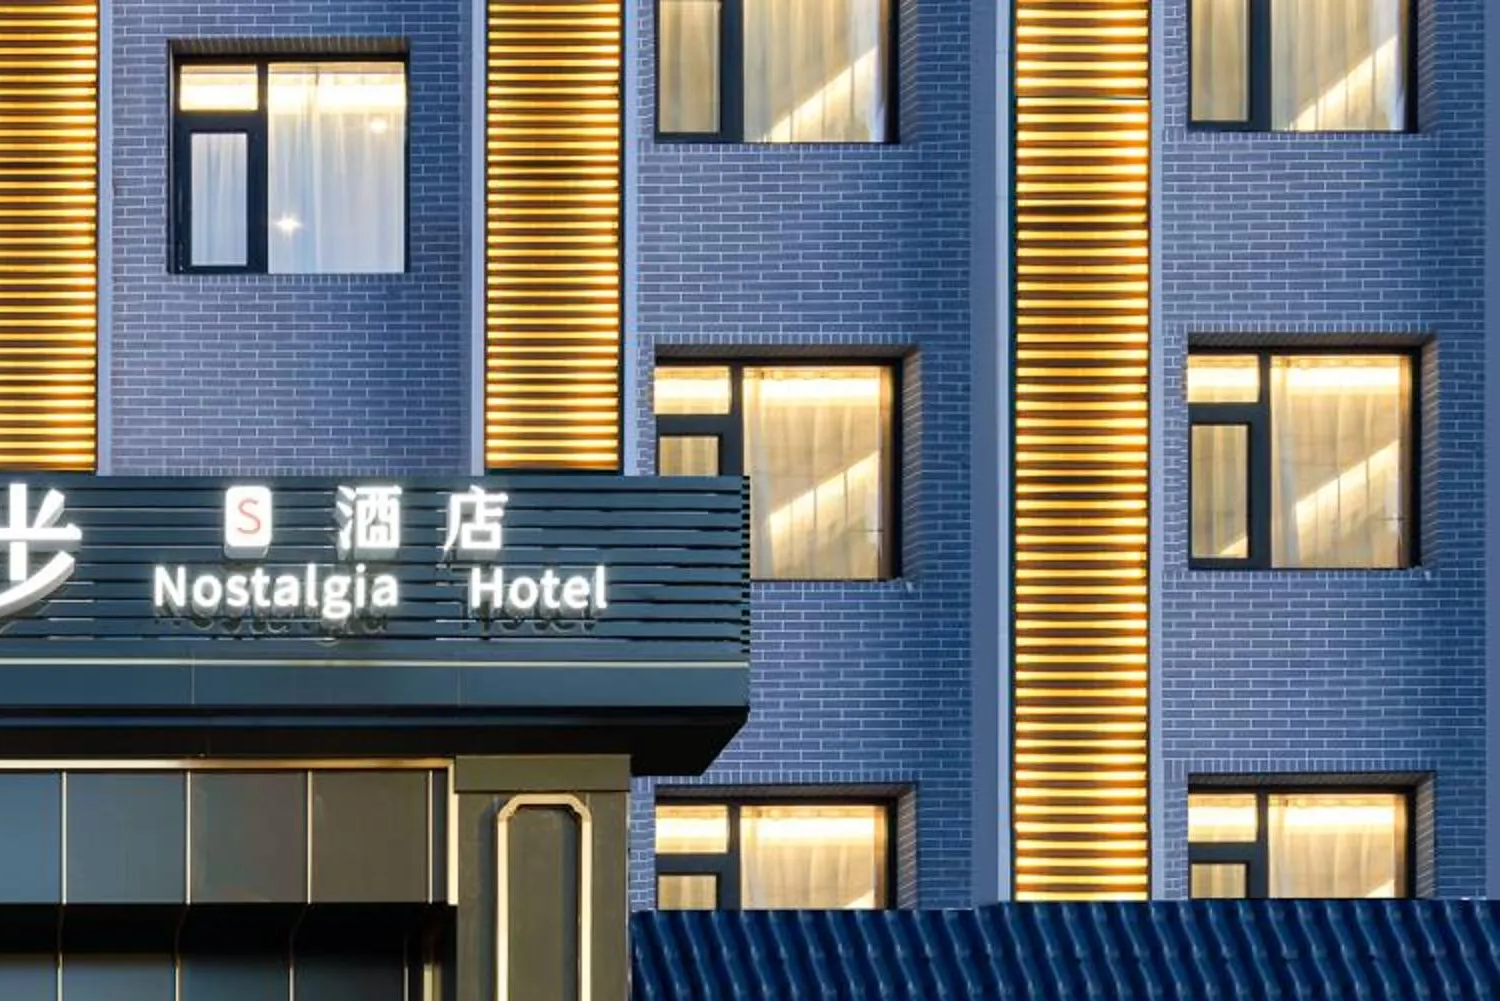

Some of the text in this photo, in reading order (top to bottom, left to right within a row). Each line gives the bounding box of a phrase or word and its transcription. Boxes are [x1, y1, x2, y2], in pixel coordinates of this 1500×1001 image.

[235, 496, 263, 536] S
[335, 484, 509, 551] 酒店
[153, 563, 607, 619] Nostalgia Hotel
